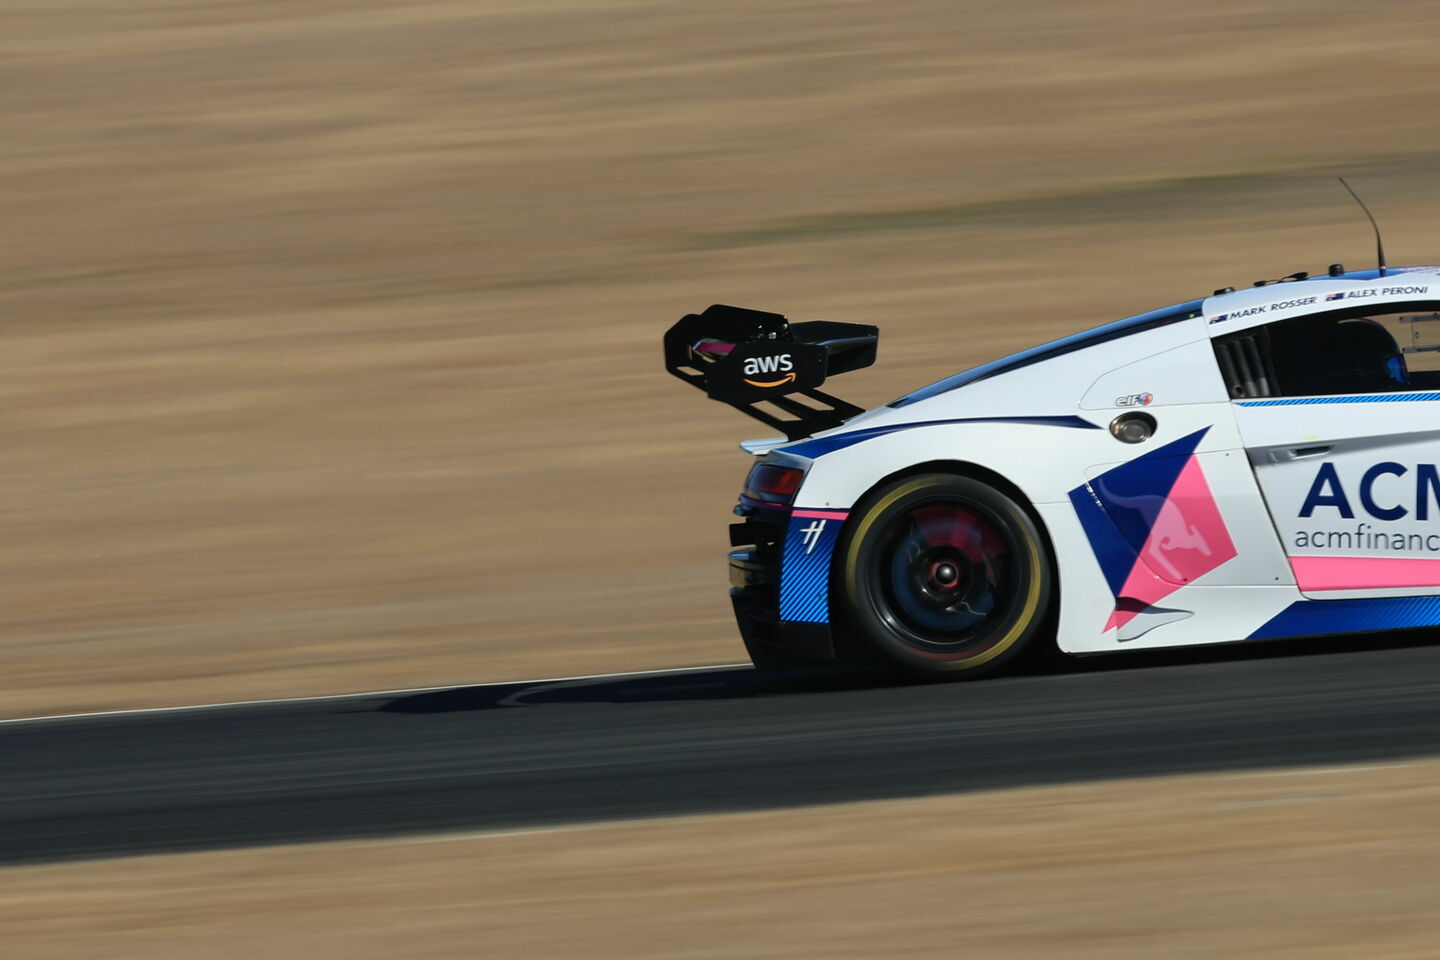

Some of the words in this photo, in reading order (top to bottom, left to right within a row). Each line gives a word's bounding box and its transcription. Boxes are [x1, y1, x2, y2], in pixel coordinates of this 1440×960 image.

[1347, 288, 1378, 299] ALEX
[1381, 286, 1428, 296] PERONI
[1230, 305, 1268, 320] MARK
[1270, 296, 1317, 311] ROSSER
[743, 354, 794, 375] aws
